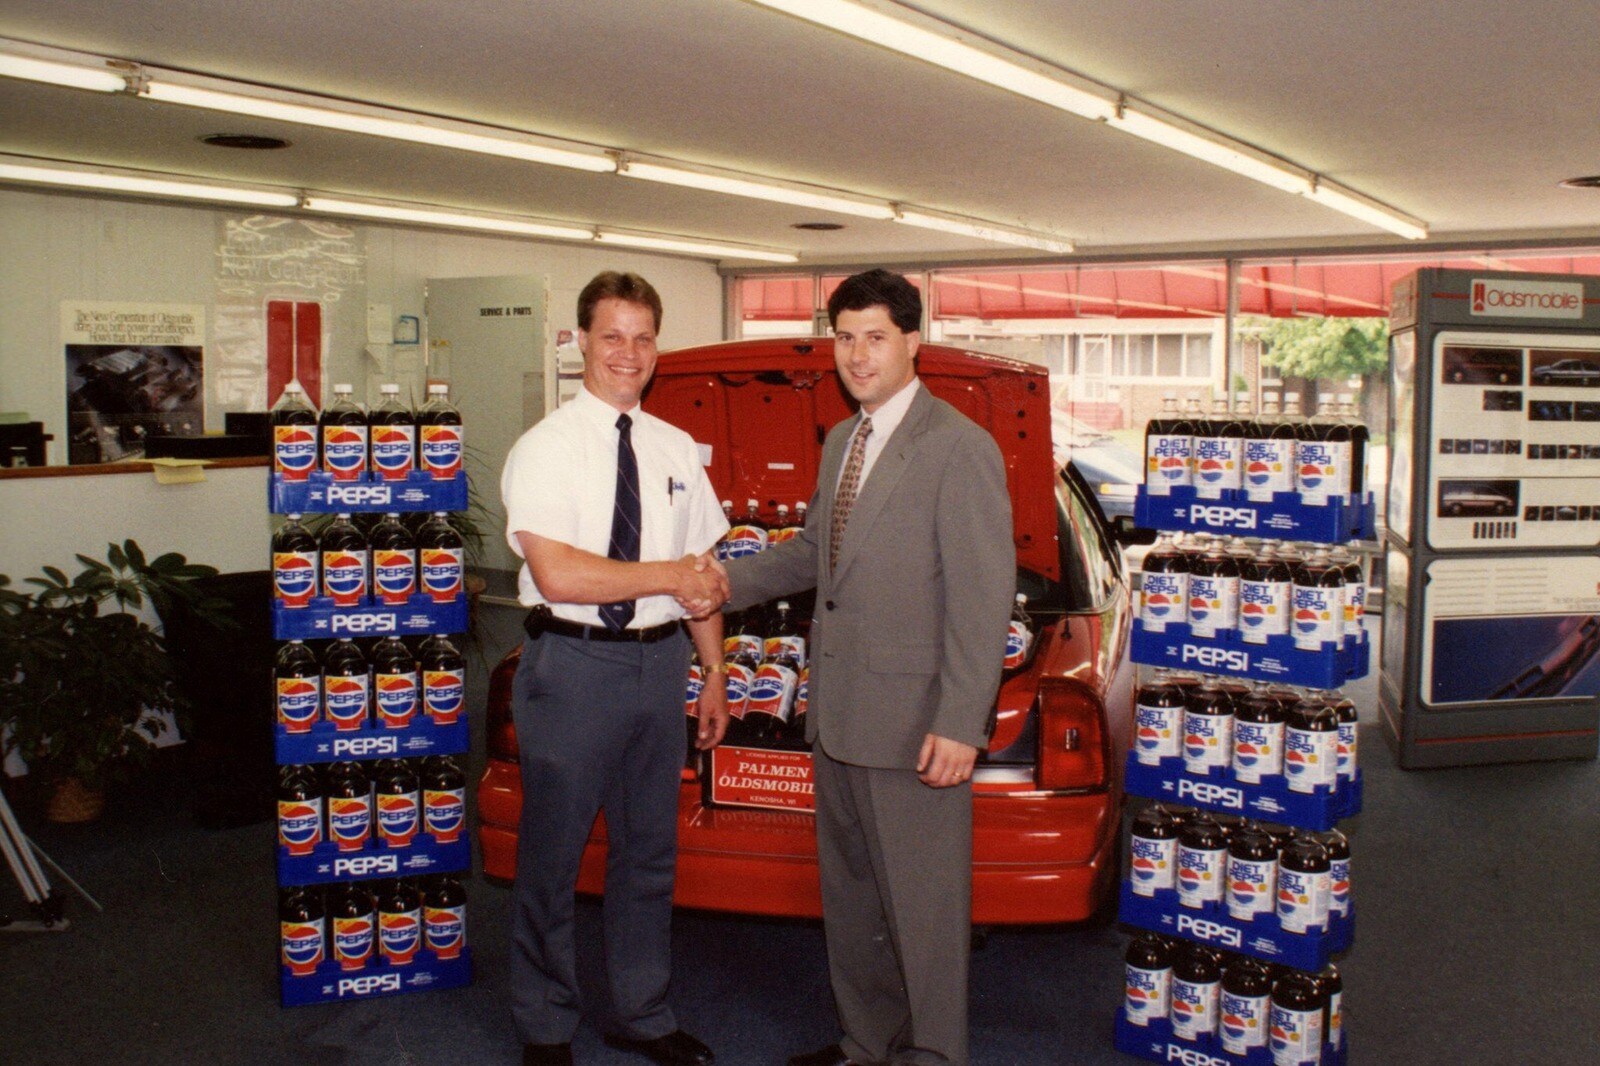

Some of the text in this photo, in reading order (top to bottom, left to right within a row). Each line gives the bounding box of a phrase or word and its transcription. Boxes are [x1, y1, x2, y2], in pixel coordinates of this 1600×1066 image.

[1487, 289, 1578, 309] Oldsmobile
[480, 307, 503, 316] SERVICE
[513, 307, 532, 315] PARTS
[276, 443, 316, 454] PEPSI
[325, 443, 365, 454] PEPSI
[373, 443, 411, 453] PEPSI
[422, 442, 461, 452] PEPSI
[1159, 438, 1187, 449] DIET
[1200, 440, 1229, 451] DIET
[1154, 447, 1190, 458] PEPSI
[1196, 449, 1231, 460] PEPSI
[1245, 451, 1278, 462] PEPSI
[1297, 454, 1331, 465] PEPSI
[327, 486, 391, 505] PEPSI
[1190, 504, 1257, 529] PEPSI
[729, 540, 762, 551] PEPSI
[275, 568, 314, 580] PEPSI
[325, 568, 364, 579] PEPSI
[376, 566, 413, 577] PEPSI
[422, 565, 460, 576] PEPSI
[1147, 575, 1175, 586] DIET
[1143, 584, 1178, 595] PEPSI
[1242, 583, 1270, 595] DIET
[1296, 588, 1324, 601] DIET
[1292, 599, 1327, 611] PEPSI
[332, 613, 396, 633] PEPSI
[1183, 644, 1249, 672] PEPSI
[728, 680, 748, 694] PSI
[754, 679, 783, 691] EPSI
[279, 693, 318, 706] PEPSI
[327, 692, 365, 704] PEPSI
[378, 691, 416, 702] PEPSI
[425, 687, 462, 699] PEPSI
[1138, 708, 1163, 721] DIET
[1136, 717, 1167, 730] PEPSI
[1186, 715, 1211, 728] DIET
[1237, 723, 1264, 736] DIET
[334, 736, 397, 756] PEPSI
[1234, 733, 1267, 746] PEPSI
[738, 762, 809, 778] PALMEN
[719, 775, 815, 794] OLDSMOBIL
[1178, 779, 1243, 809] PEPSI
[379, 808, 417, 821] PEPSI
[425, 806, 463, 817] PEPSI
[280, 816, 318, 829] PEPSI
[331, 812, 370, 825] PEPSI
[1133, 839, 1160, 852] DIET
[1131, 849, 1164, 861] PEPSI
[1178, 849, 1205, 863] DIET
[334, 854, 398, 877] PEPSI
[1232, 861, 1261, 874] DIET
[1229, 870, 1264, 884] PEPSI
[381, 926, 418, 939] PEPSI
[426, 922, 462, 934] PEPSI
[1177, 913, 1242, 948] PEPSI
[282, 937, 321, 949] PEPSI
[336, 931, 373, 944] PEPSI
[1127, 967, 1153, 981] DIET
[338, 973, 400, 996] PEPSI
[1172, 981, 1198, 995] DIET
[1223, 994, 1252, 1008] DIET
